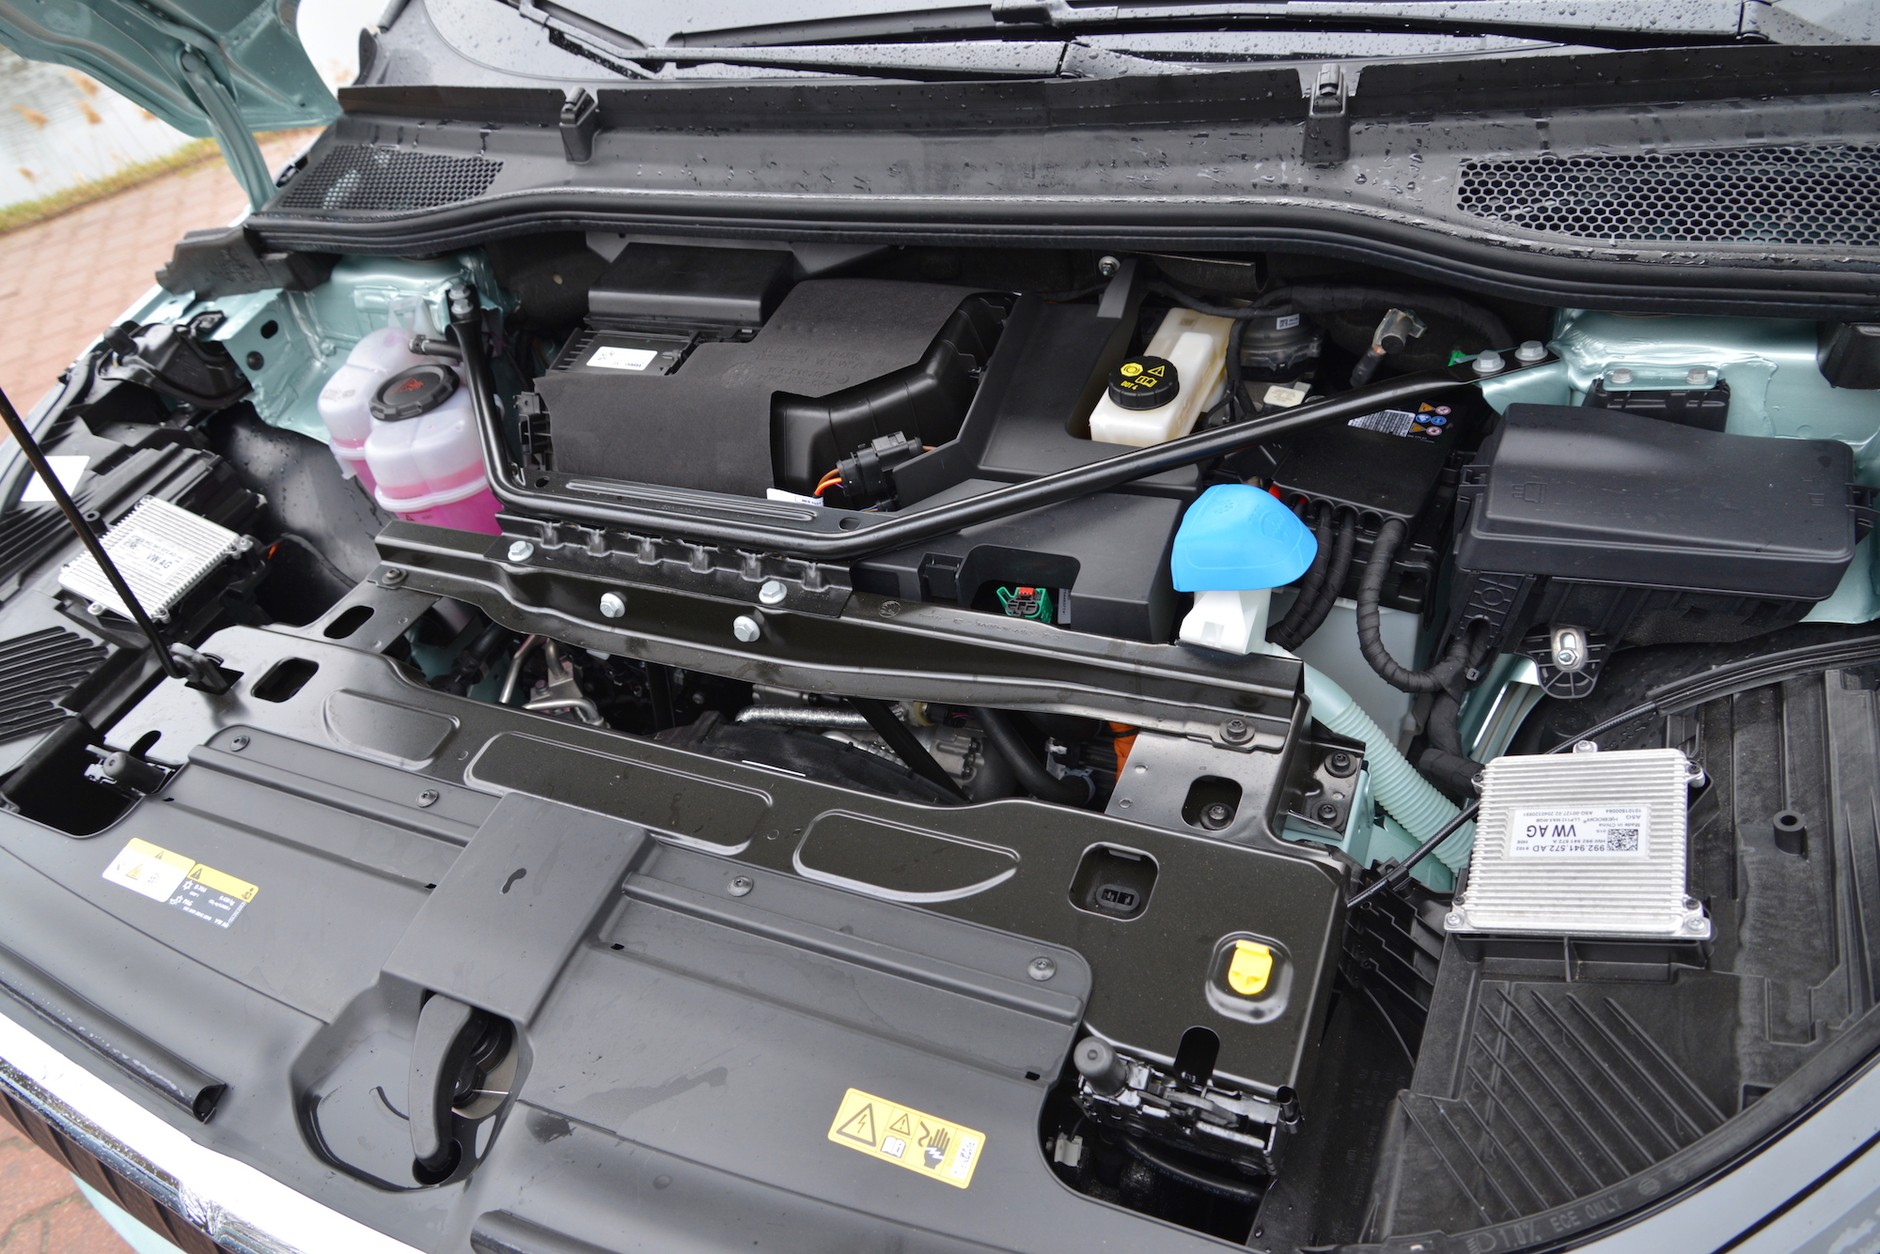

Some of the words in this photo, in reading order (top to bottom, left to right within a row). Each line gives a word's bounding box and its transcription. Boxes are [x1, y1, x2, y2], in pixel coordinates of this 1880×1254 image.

[147, 553, 160, 563] VW
[159, 559, 173, 569] AG
[1526, 824, 1549, 838] AG
[1552, 824, 1577, 838] VW
[1550, 1210, 1581, 1232] ECE
[1584, 1193, 1623, 1219] ONLY
